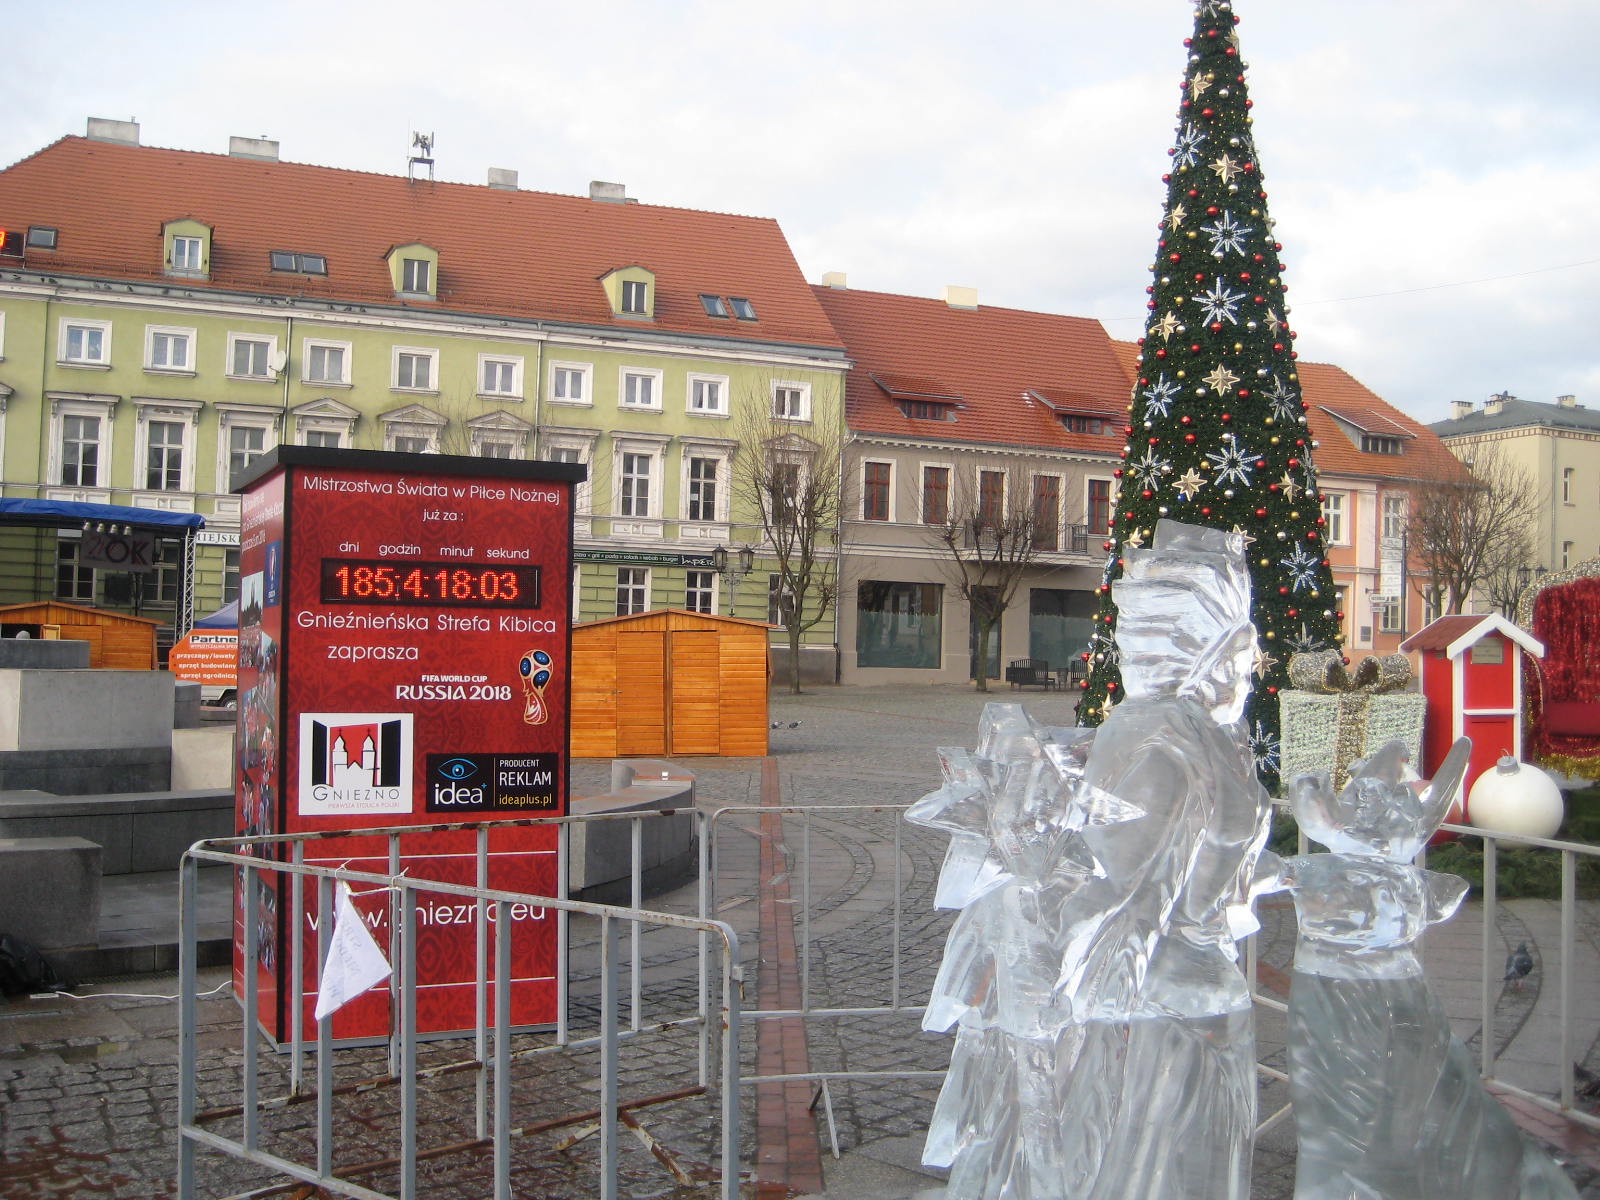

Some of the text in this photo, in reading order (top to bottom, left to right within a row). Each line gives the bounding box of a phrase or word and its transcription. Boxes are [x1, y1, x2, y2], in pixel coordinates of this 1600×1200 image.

[303, 476, 560, 506] Mistrzostwa Świata w Piłce Nożnej
[423, 508, 441, 522] już
[197, 533, 241, 544] IEJSKI
[339, 541, 530, 560] dni godzin minut sekund
[297, 610, 557, 633] Gnieźnieńska Strefa Kibica
[327, 645, 419, 663] zaprasza
[421, 674, 488, 683] FIFA WORLD CUP
[395, 684, 512, 701] RUSSIA 2018
[499, 759, 540, 768] PRODUCENT
[499, 771, 552, 787] REKLAM
[312, 785, 400, 801] GNIEZNO
[499, 793, 552, 807] ideaplus.pl
